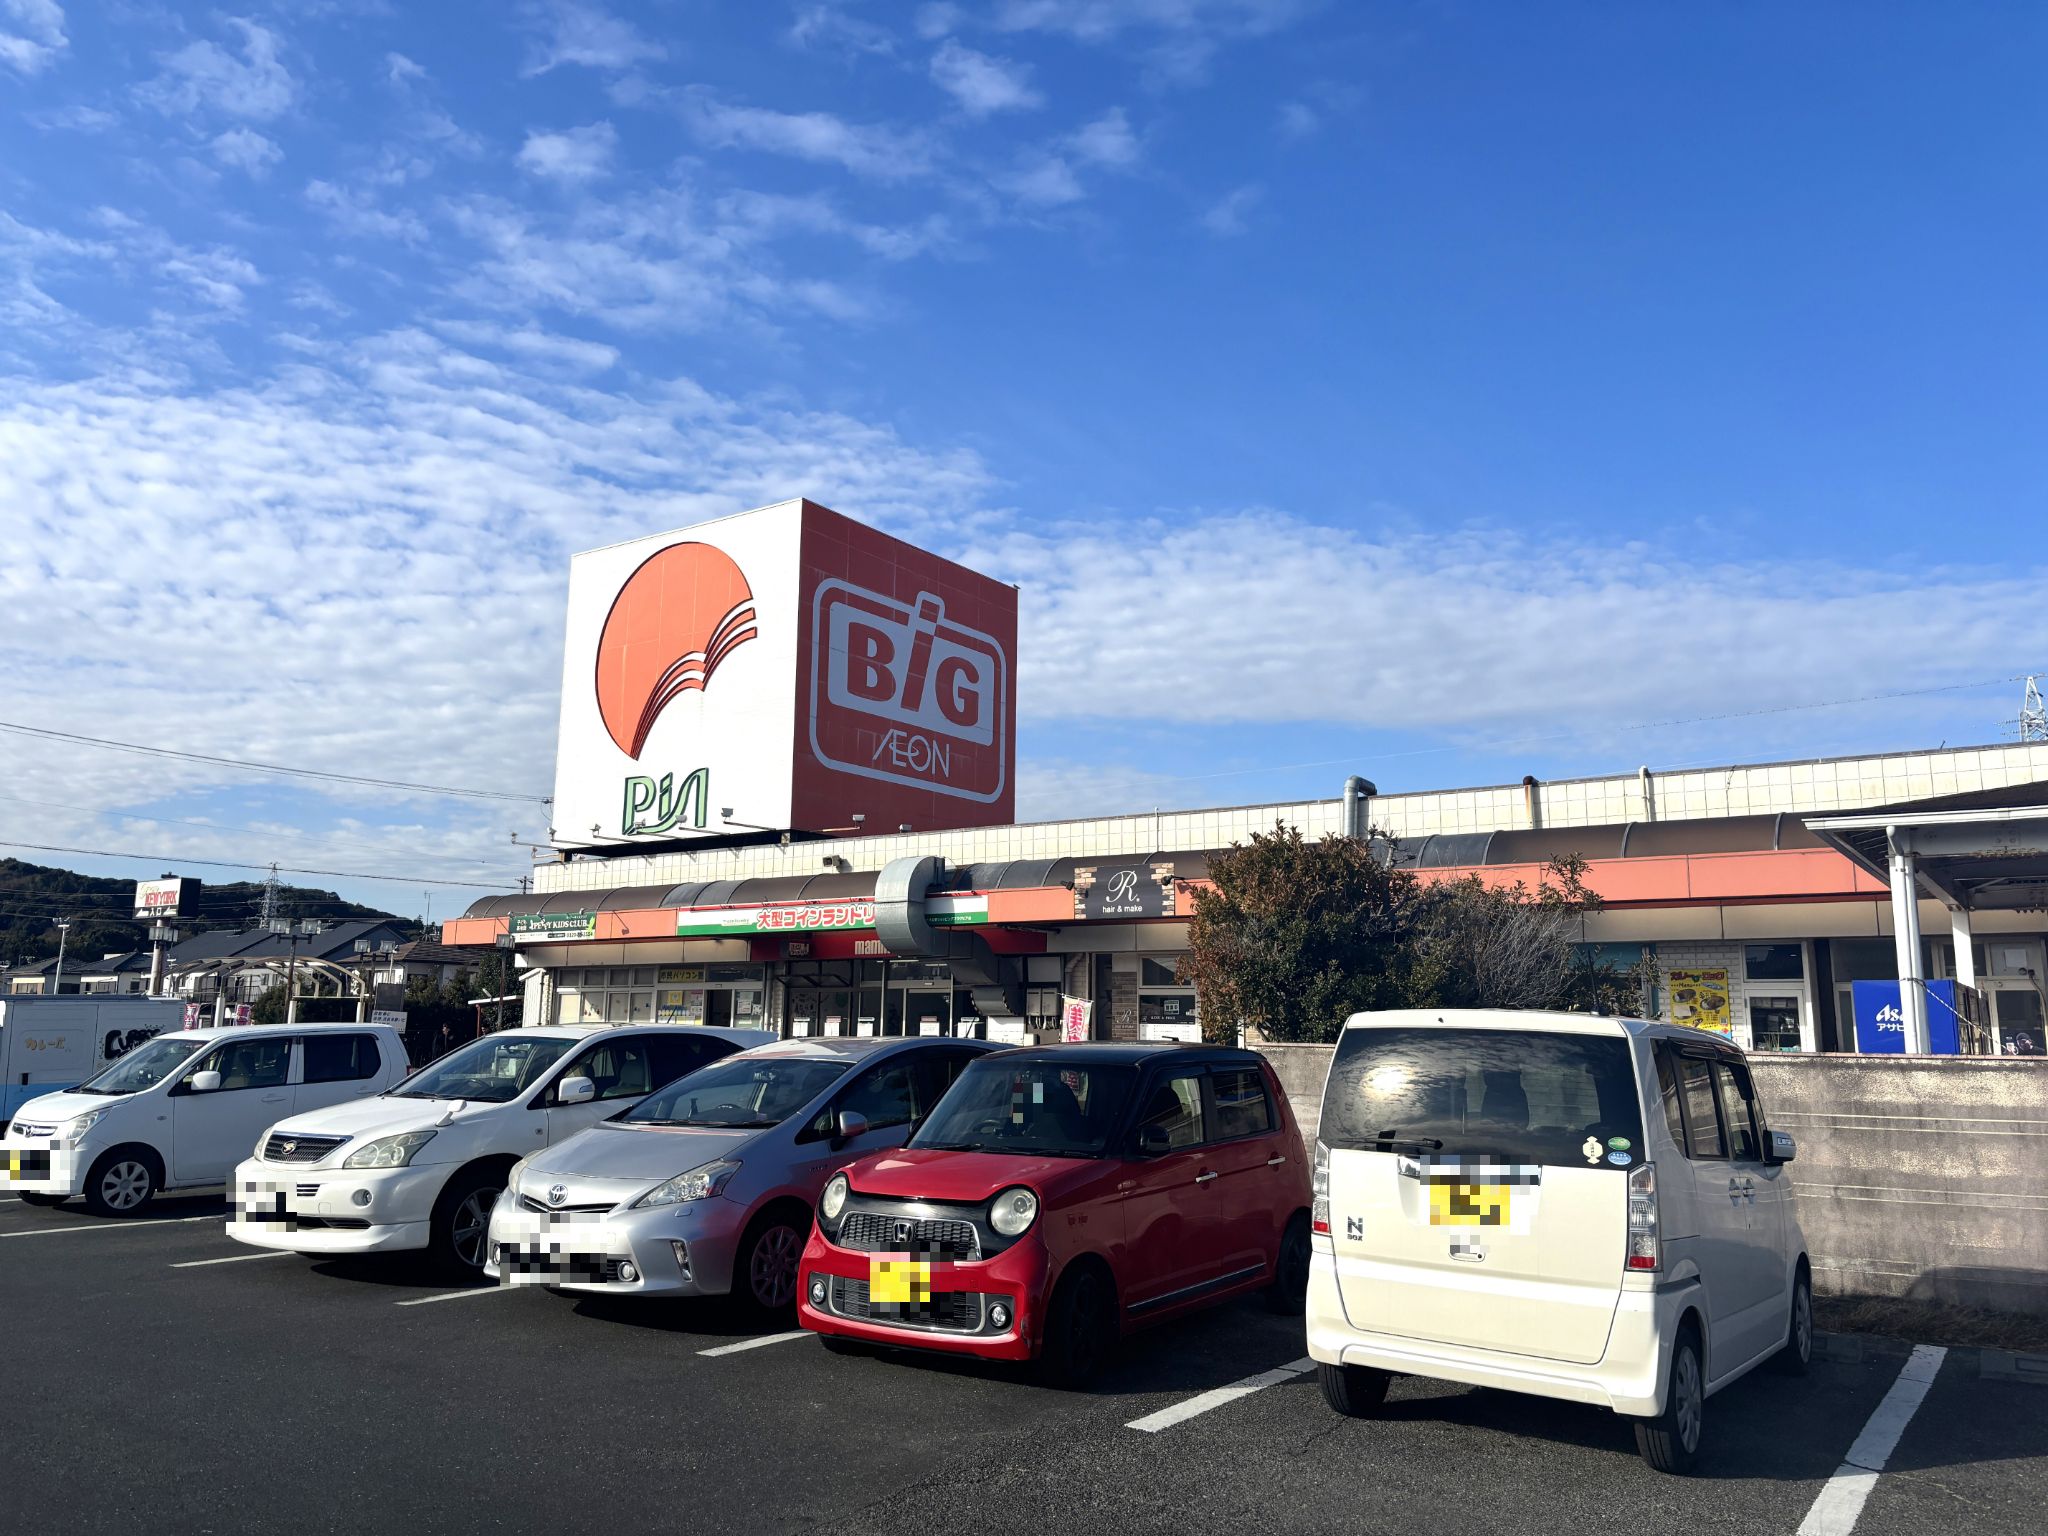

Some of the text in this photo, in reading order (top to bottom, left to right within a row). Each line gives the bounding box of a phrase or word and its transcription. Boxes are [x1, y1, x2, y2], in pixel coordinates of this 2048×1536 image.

[150, 907, 162, 917] 入口
[1102, 905, 1115, 913] hair
[552, 921, 569, 929] KIDS
[569, 919, 588, 928] CLUB
[1347, 1215, 1363, 1235] N
